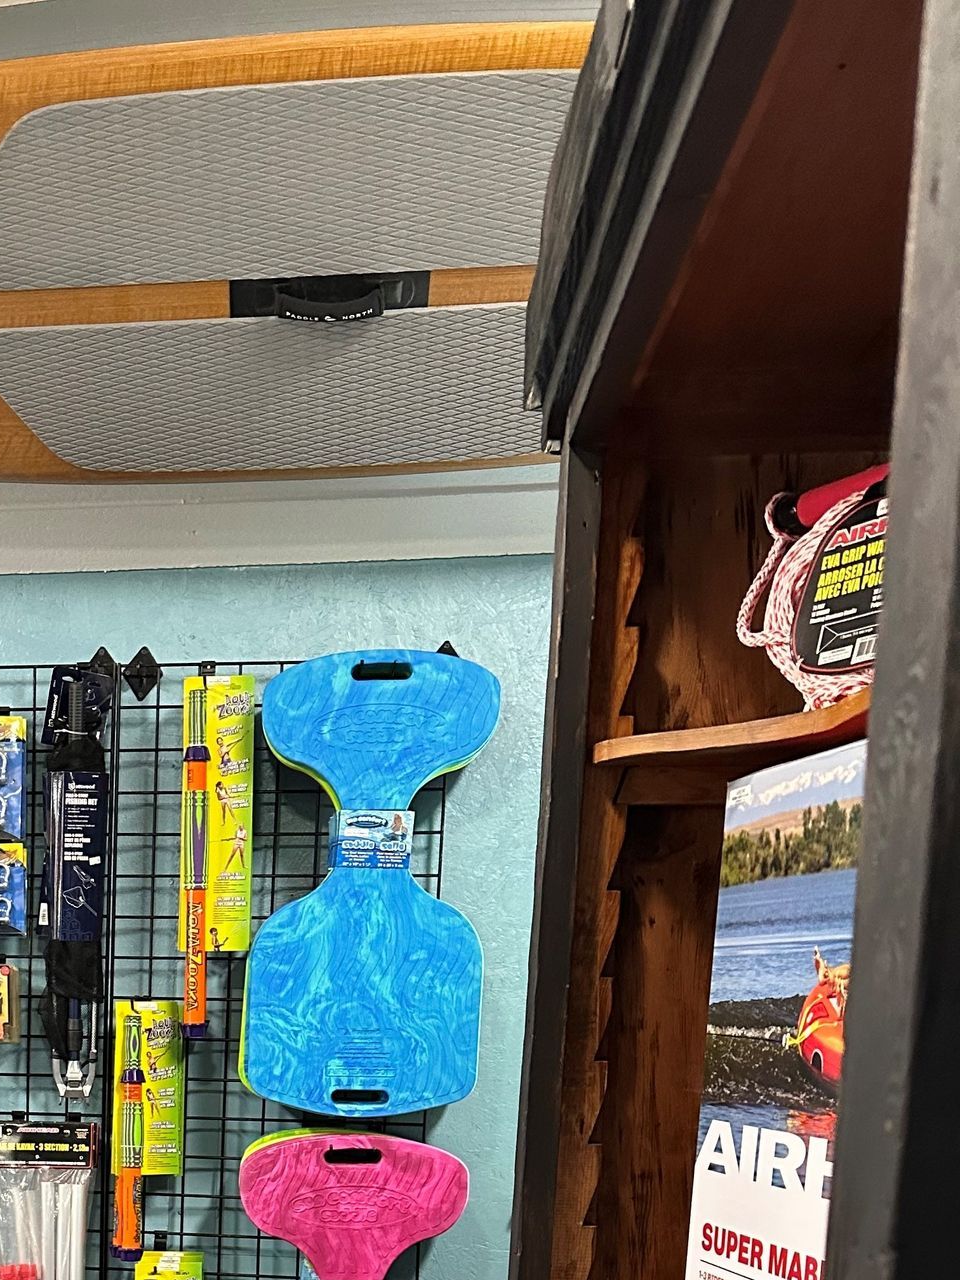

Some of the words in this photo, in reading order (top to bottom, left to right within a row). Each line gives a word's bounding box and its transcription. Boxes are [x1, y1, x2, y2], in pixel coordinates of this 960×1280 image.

[286, 311, 319, 322] PADDLE
[342, 308, 373, 321] NORTH
[821, 553, 840, 571] EVA
[842, 545, 866, 567] GRIP
[818, 561, 864, 588] ARROSER
[864, 560, 878, 574] LA
[814, 585, 841, 602] AVEC
[842, 579, 860, 595] EVA
[701, 1222, 763, 1271] SUPER
[699, 1270, 707, 1280] 1-3
